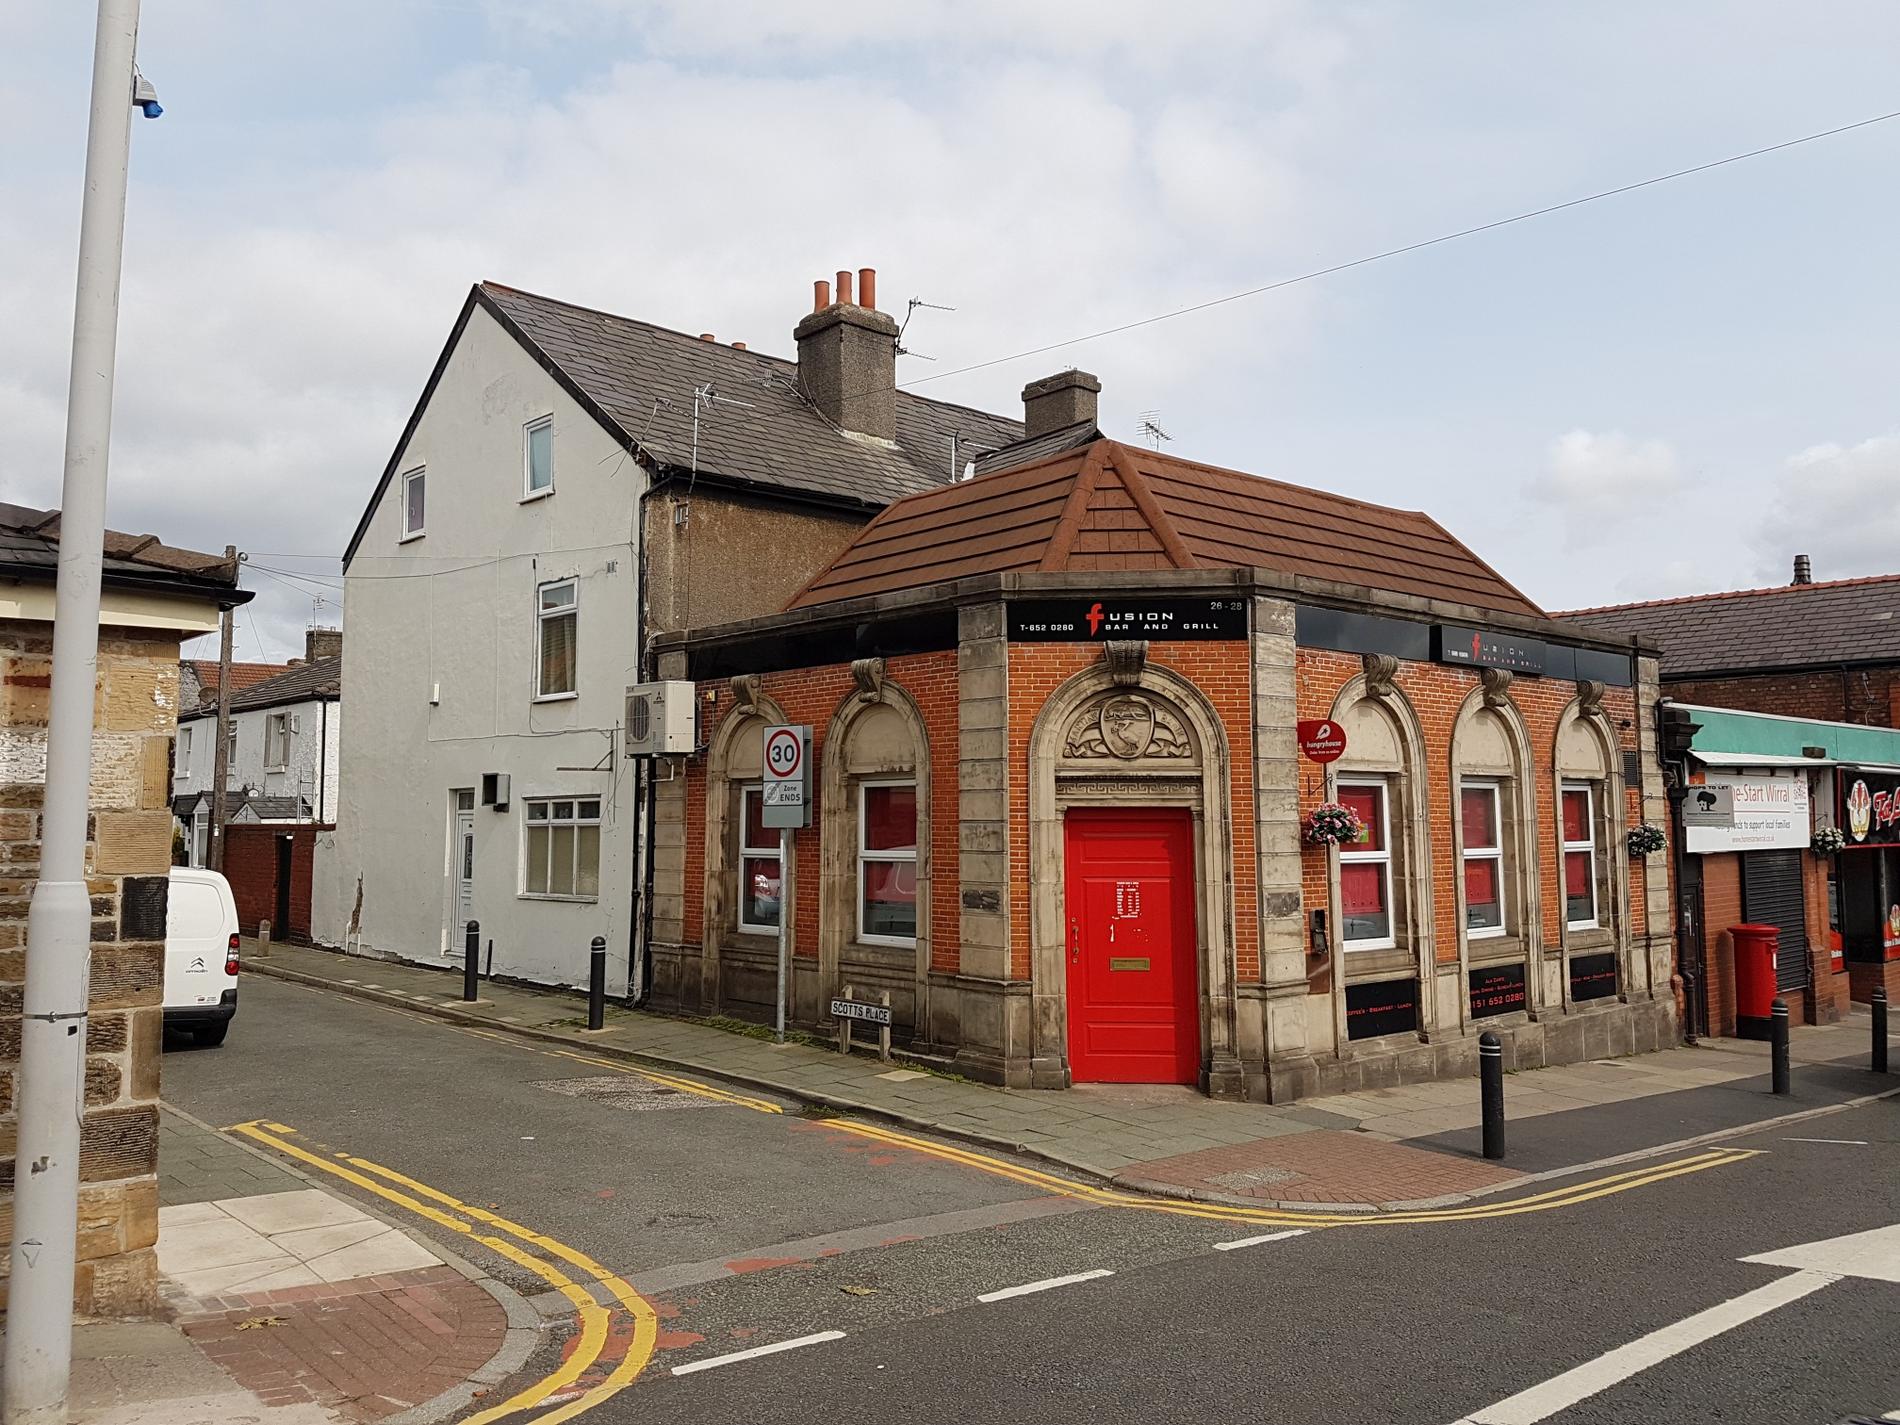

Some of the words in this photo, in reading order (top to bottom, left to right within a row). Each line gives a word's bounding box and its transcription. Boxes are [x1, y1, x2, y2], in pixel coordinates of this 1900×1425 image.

[1050, 623, 1074, 632] 0280
[1306, 740, 1342, 749] hungryhouse
[772, 744, 796, 764] 30
[783, 784, 798, 792] Zone
[1766, 785, 1790, 803] Wirral
[780, 793, 801, 802] ENDS
[1743, 820, 1749, 829] to
[1749, 820, 1765, 832] support
[1766, 819, 1775, 829] local
[1472, 999, 1486, 1009] 151
[1488, 995, 1504, 1006] 652
[1505, 992, 1525, 1003] 0280
[833, 1002, 864, 1017] SCOTTS
[865, 1007, 889, 1022] PLACE
